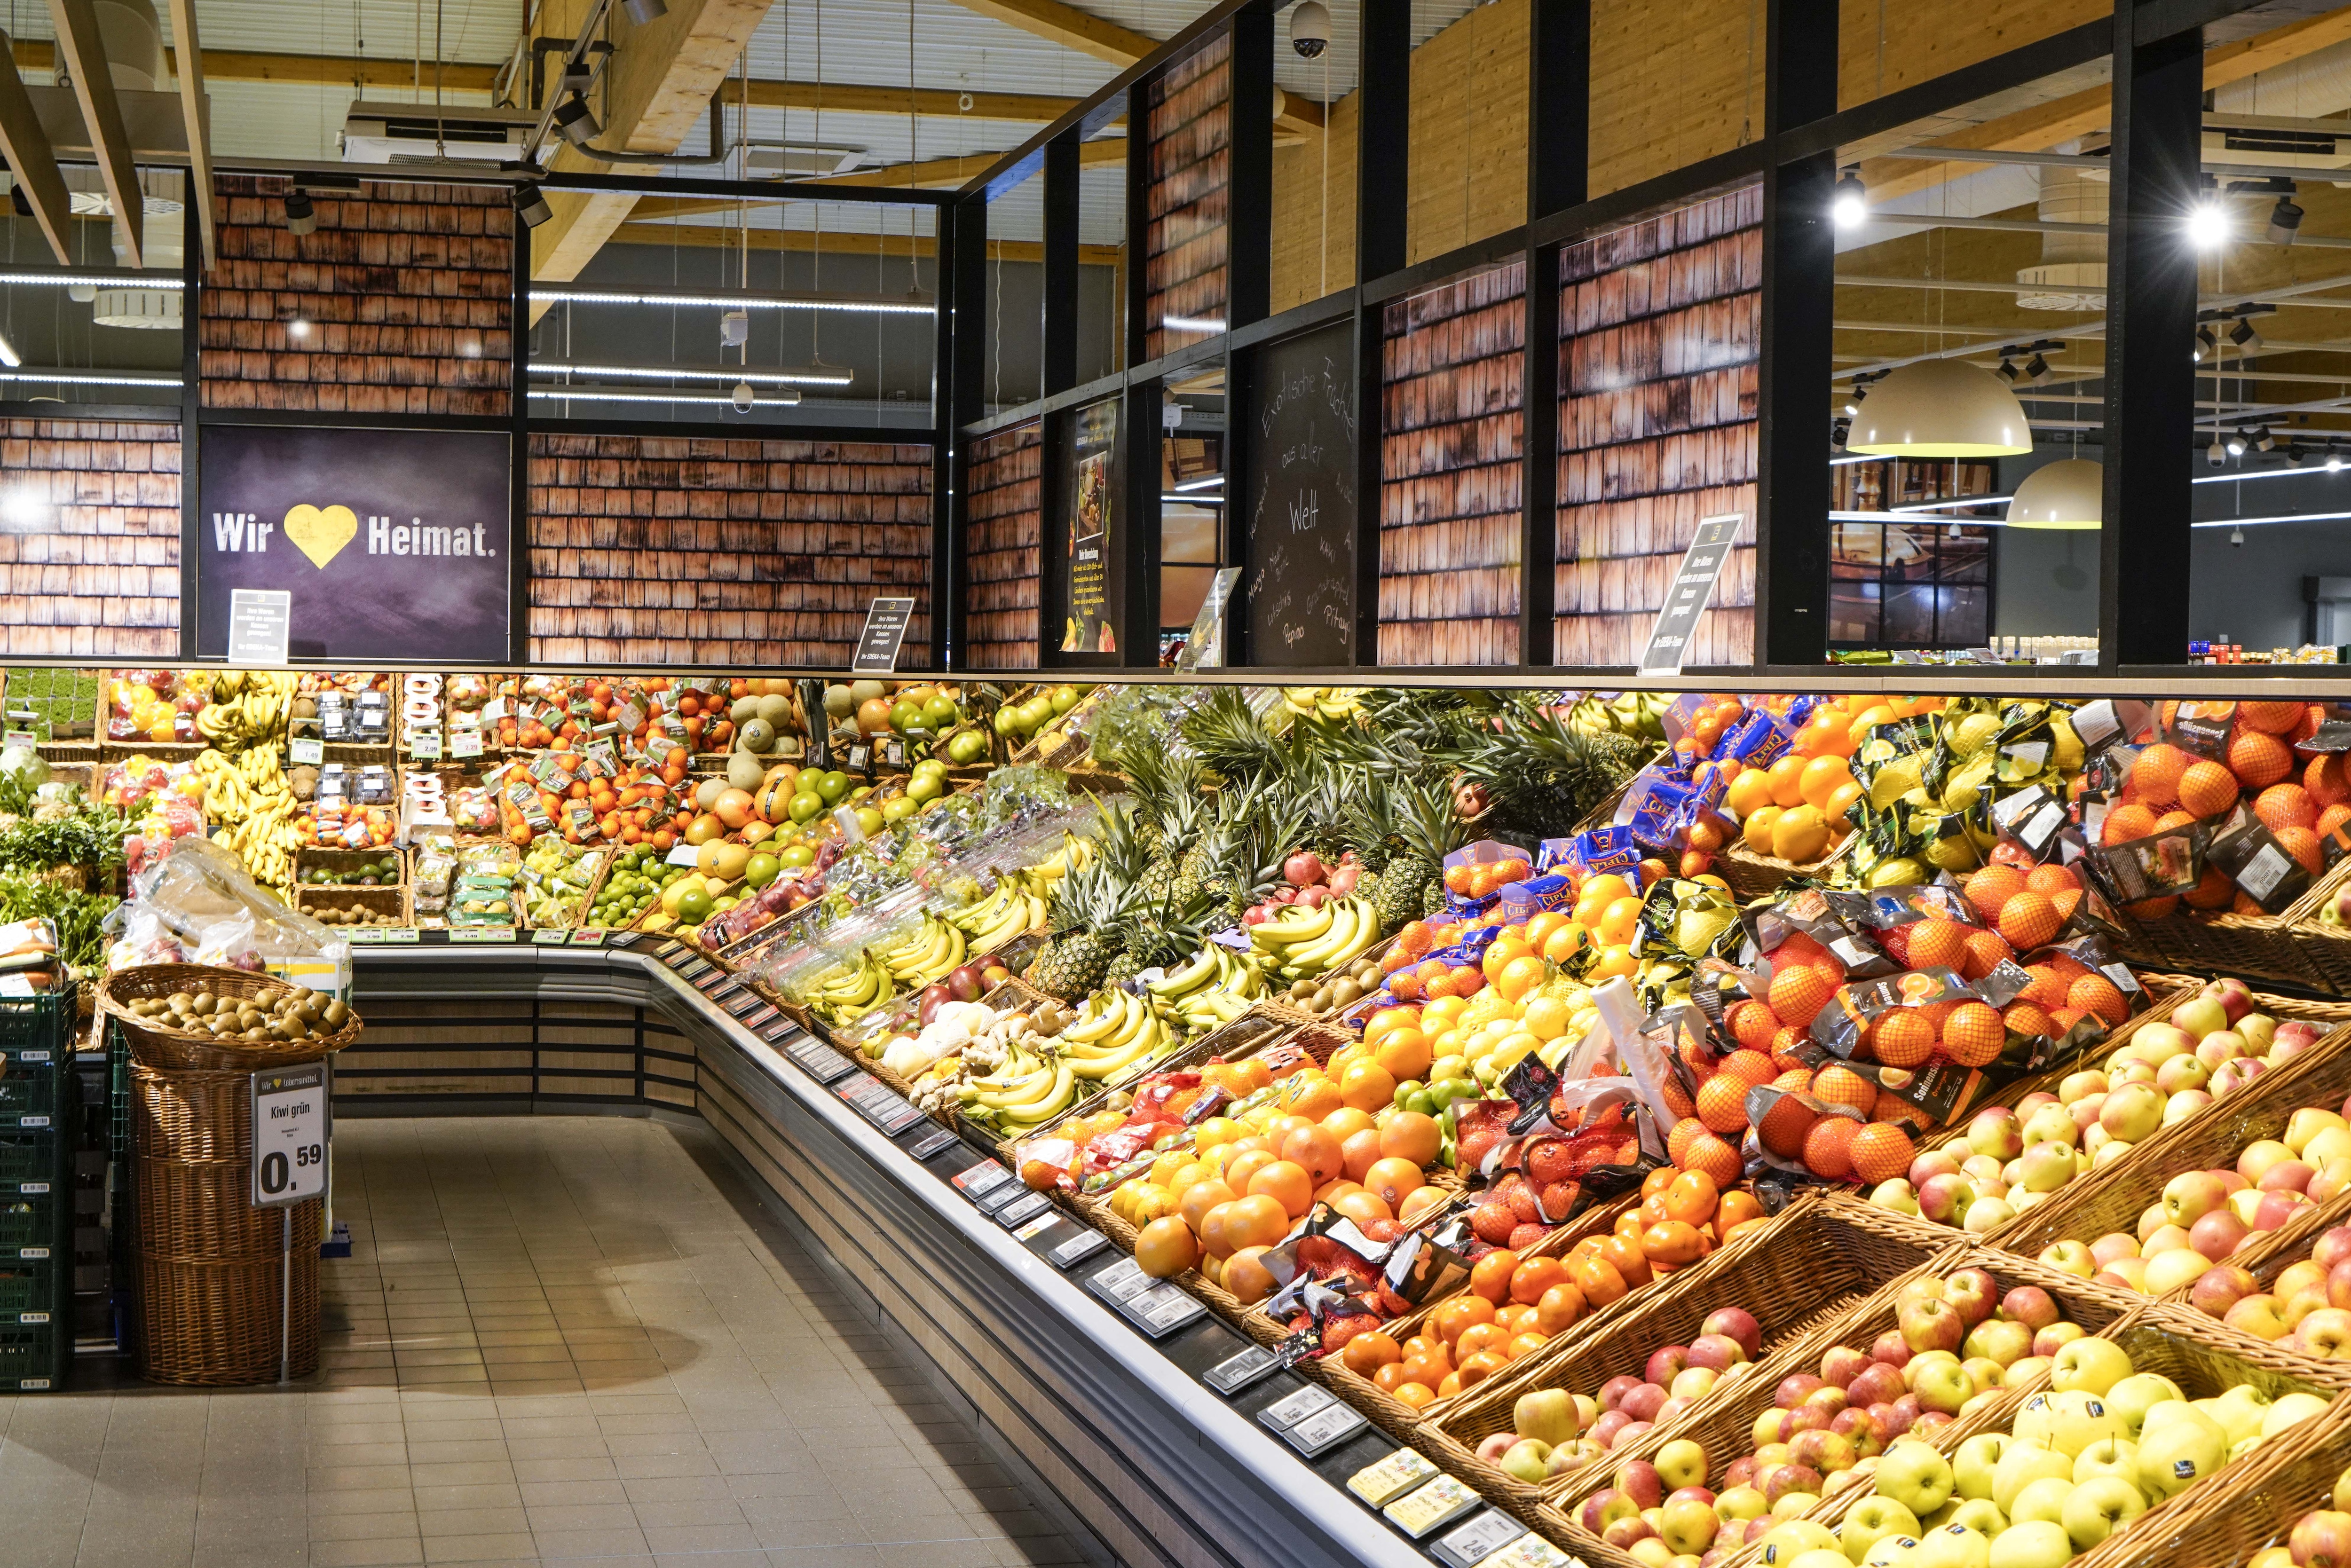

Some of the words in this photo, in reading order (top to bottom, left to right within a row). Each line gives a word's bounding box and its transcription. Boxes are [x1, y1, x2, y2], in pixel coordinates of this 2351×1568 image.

[1262, 368, 1315, 438] Exotische
[1282, 446, 1296, 468] aus
[1301, 421, 1324, 467] aller
[1289, 489, 1318, 534] Welt
[213, 513, 273, 552] Wir
[369, 517, 496, 557] Heimat.
[1670, 703, 1690, 730] IPLA
[1590, 852, 1628, 871] CIPLA
[1542, 888, 1571, 906] CIPLA
[1950, 973, 1963, 988] EDEKA
[262, 1081, 271, 1090] Wir
[283, 1074, 317, 1087] Lebensmittel.
[1932, 1071, 1949, 1097] Orangen
[271, 1104, 288, 1119] Kiwi
[291, 1102, 310, 1119] grün
[1513, 1112, 1532, 1127] Clemen
[1531, 1103, 1544, 1117] Gold
[1283, 1408, 1304, 1420] 3.99
[1310, 1427, 1332, 1442] 3.99
[1462, 1539, 1488, 1557] 2.49
